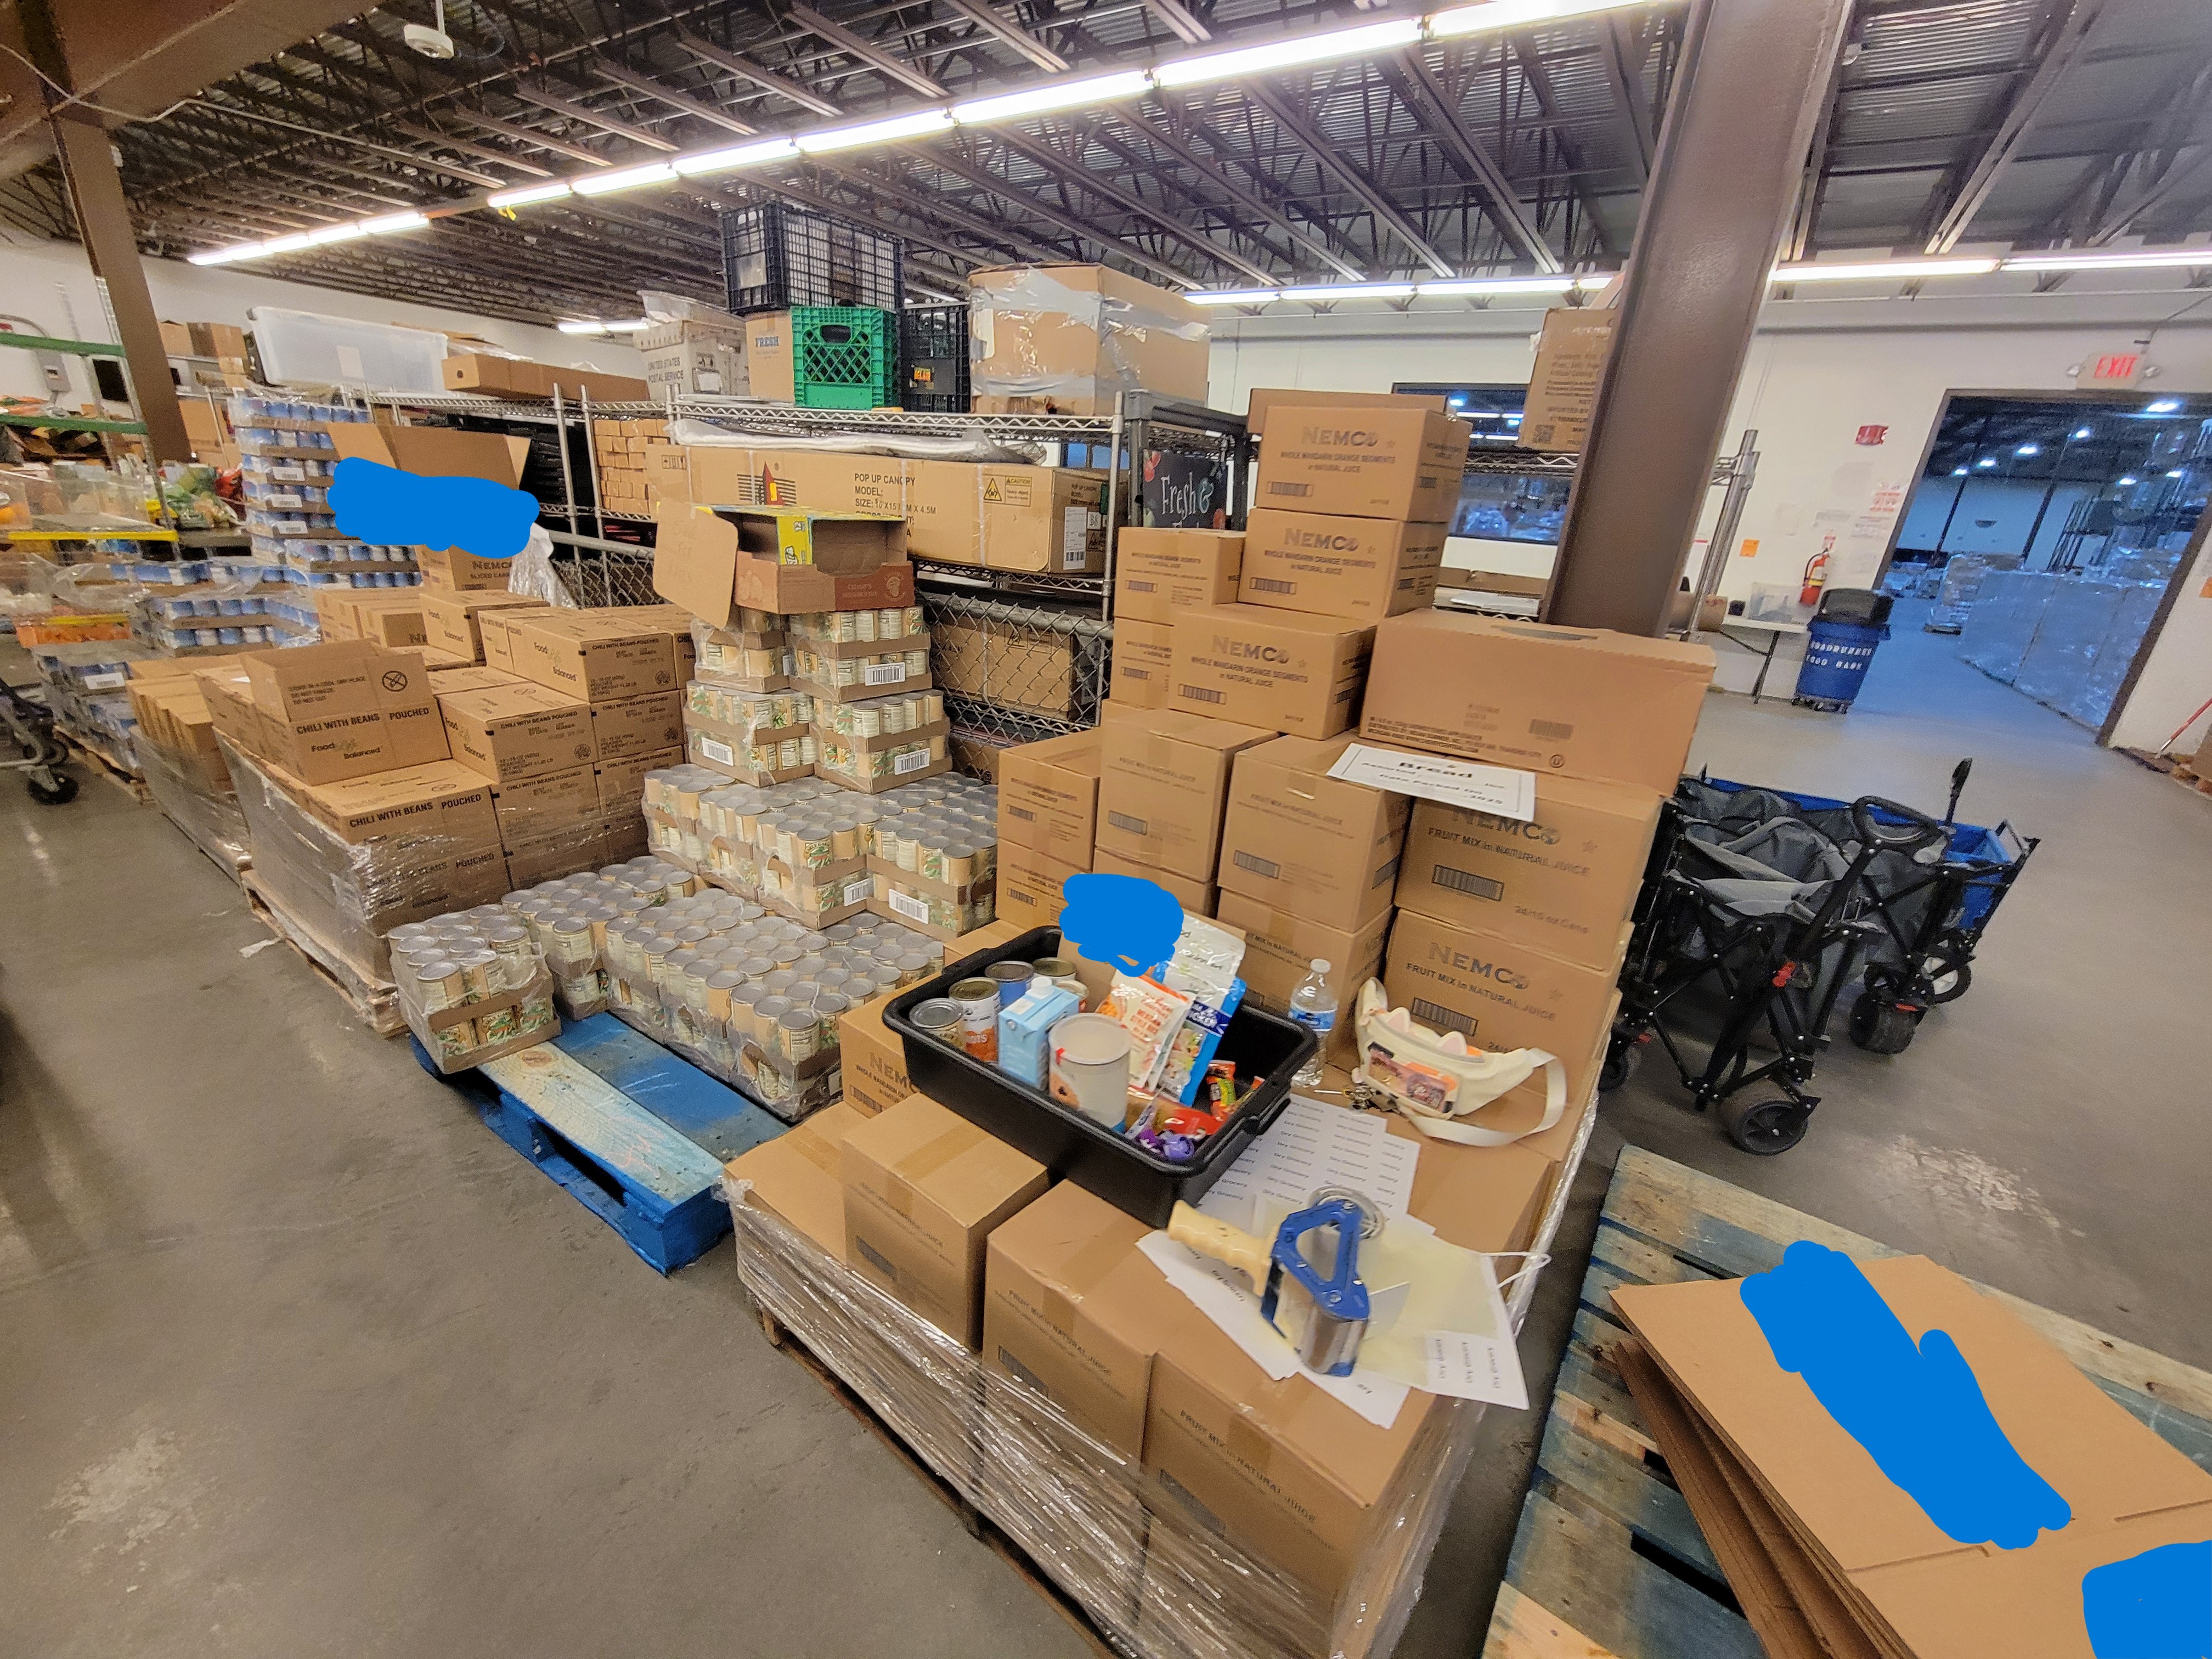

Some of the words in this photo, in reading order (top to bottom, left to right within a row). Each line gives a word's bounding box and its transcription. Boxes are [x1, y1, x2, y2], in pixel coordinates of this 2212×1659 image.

[755, 336, 779, 347] FRESH
[664, 357, 680, 368] STATES
[2093, 357, 2137, 378] EXIT
[1302, 426, 1378, 447] NEMCO
[855, 473, 870, 482] POP
[871, 474, 882, 483] UP
[855, 486, 883, 496] MODEL:
[1161, 471, 1197, 520] Fresh
[855, 498, 873, 509] SIZE:
[920, 506, 936, 515] 4.5M
[1284, 528, 1358, 551] NEMCO
[534, 642, 548, 654] Food
[1211, 635, 1289, 664] NEMCO
[1226, 674, 1254, 684] NATURAL
[1244, 666, 1272, 677] ORANGE
[297, 724, 323, 735] CHILI
[324, 719, 349, 730] WITH
[351, 713, 380, 725] BEANS
[389, 707, 430, 720] POUCHED
[312, 742, 335, 752] Food
[1399, 761, 1472, 778] Bread
[349, 816, 375, 828] CHILI
[378, 809, 402, 822] WITH
[404, 802, 433, 815] BEANS
[441, 794, 482, 809] POUCHED
[1427, 827, 1460, 841] FRUIT
[1462, 836, 1482, 847] MIX
[1494, 844, 1551, 866] NATURAL
[1427, 942, 1528, 990] NEMCO
[1406, 962, 1436, 978] FRUIT
[1437, 973, 1456, 986] MIX
[1469, 985, 1519, 1009] NATURAL
[1521, 1005, 1556, 1022] JUICE
[1222, 1179, 1248, 1188] Grocery
